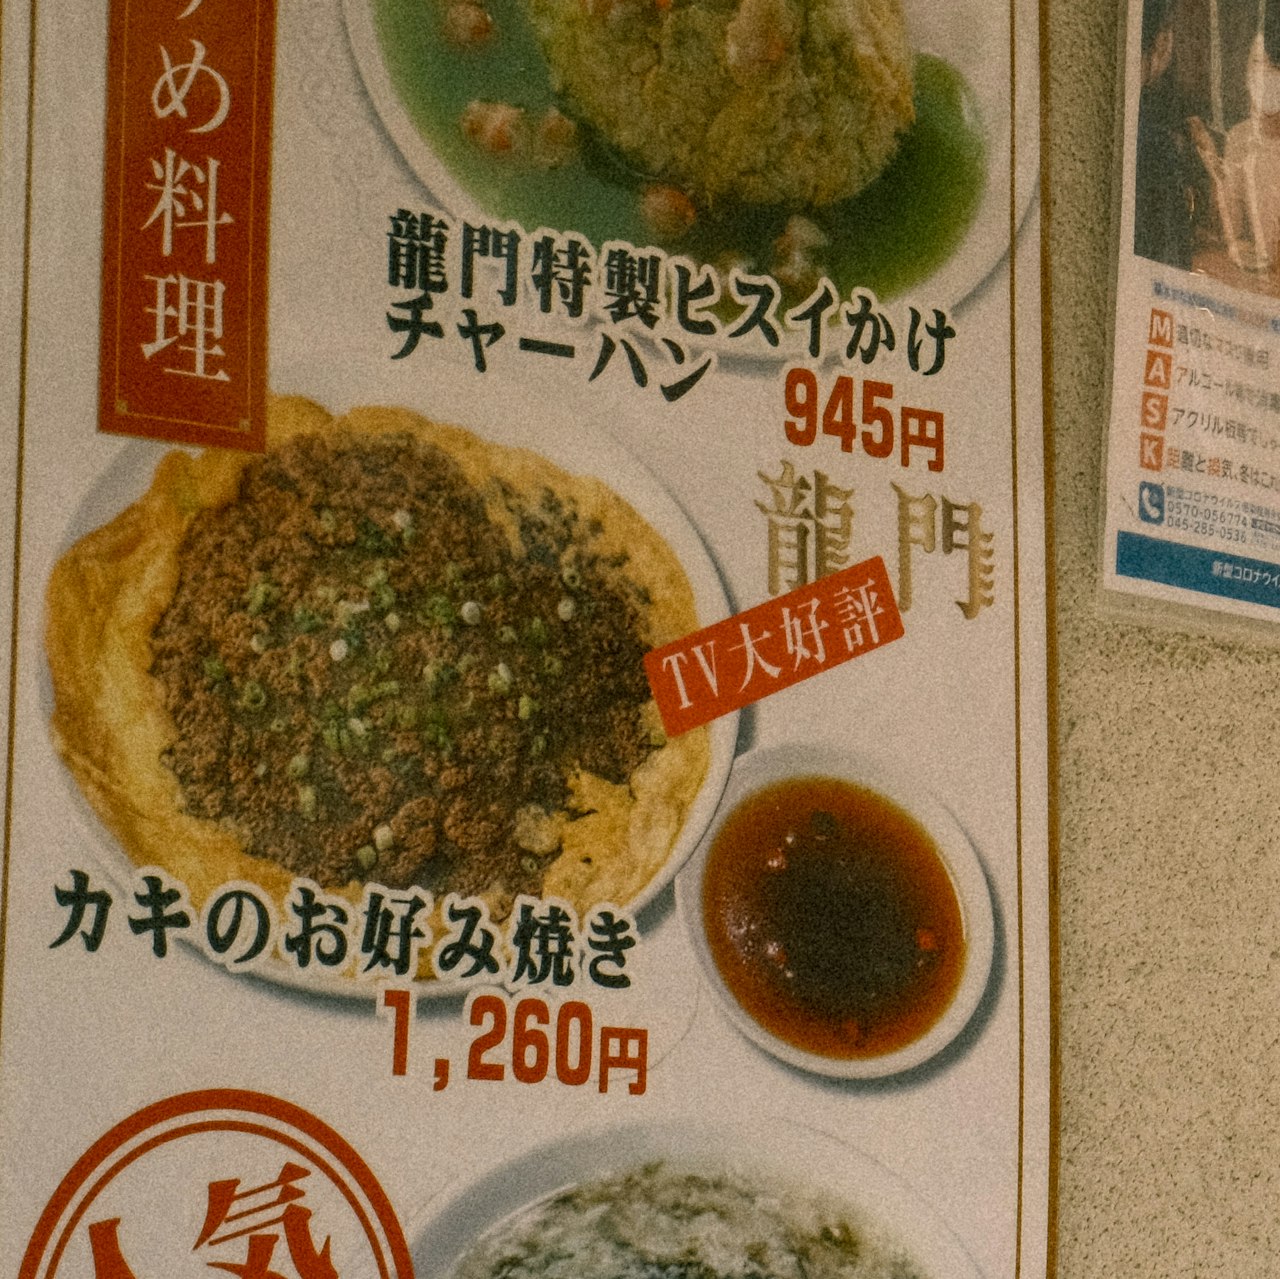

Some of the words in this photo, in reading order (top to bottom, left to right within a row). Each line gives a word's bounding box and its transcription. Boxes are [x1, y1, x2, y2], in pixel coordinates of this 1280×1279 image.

[386, 208, 957, 376] 龍門特製ヒスイかけ
[386, 293, 712, 403] チャーハン
[783, 367, 945, 473] 945円
[754, 459, 996, 620] 龍門
[1166, 502, 1249, 528] 0570-056774
[662, 578, 885, 710] TV大好評
[49, 869, 637, 989] カキのお好み焼き
[384, 989, 649, 1095] 1,260円
